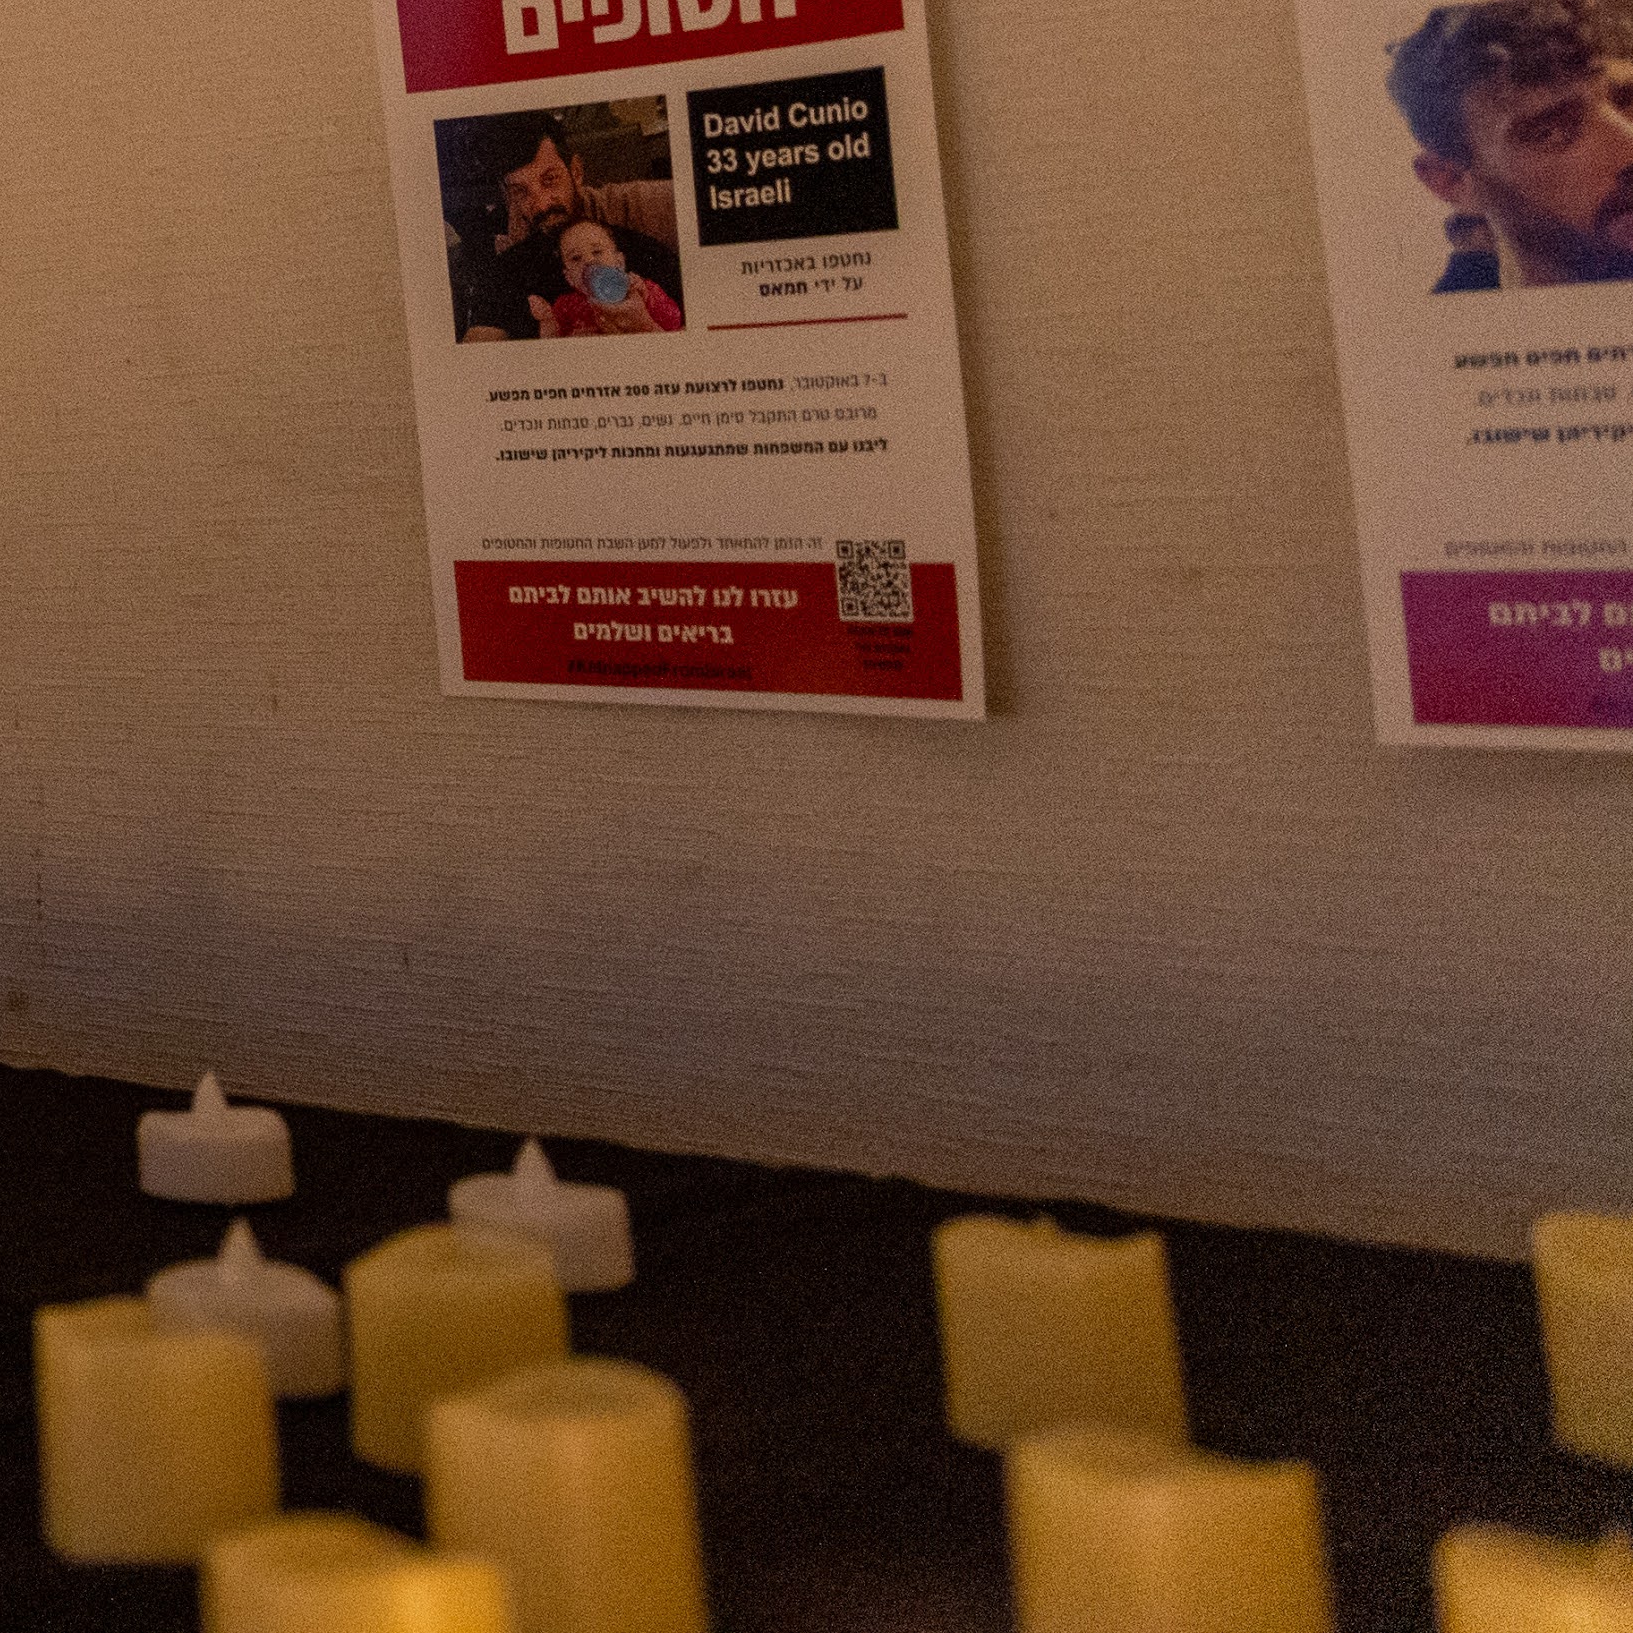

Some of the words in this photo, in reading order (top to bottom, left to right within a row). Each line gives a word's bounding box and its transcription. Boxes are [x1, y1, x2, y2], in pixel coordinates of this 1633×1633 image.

[703, 105, 780, 138] David
[787, 96, 868, 128] Cunio
[706, 147, 738, 173] 33
[744, 143, 820, 176] years
[826, 131, 870, 161] old
[709, 177, 791, 209] Israeli
[507, 583, 571, 604] לביתם
[575, 586, 631, 605] אותם
[636, 584, 706, 606] להשיב
[711, 585, 744, 607] לנו
[749, 588, 798, 609] עזרו
[572, 620, 652, 641] ושלמים
[656, 623, 734, 644] בריאים
